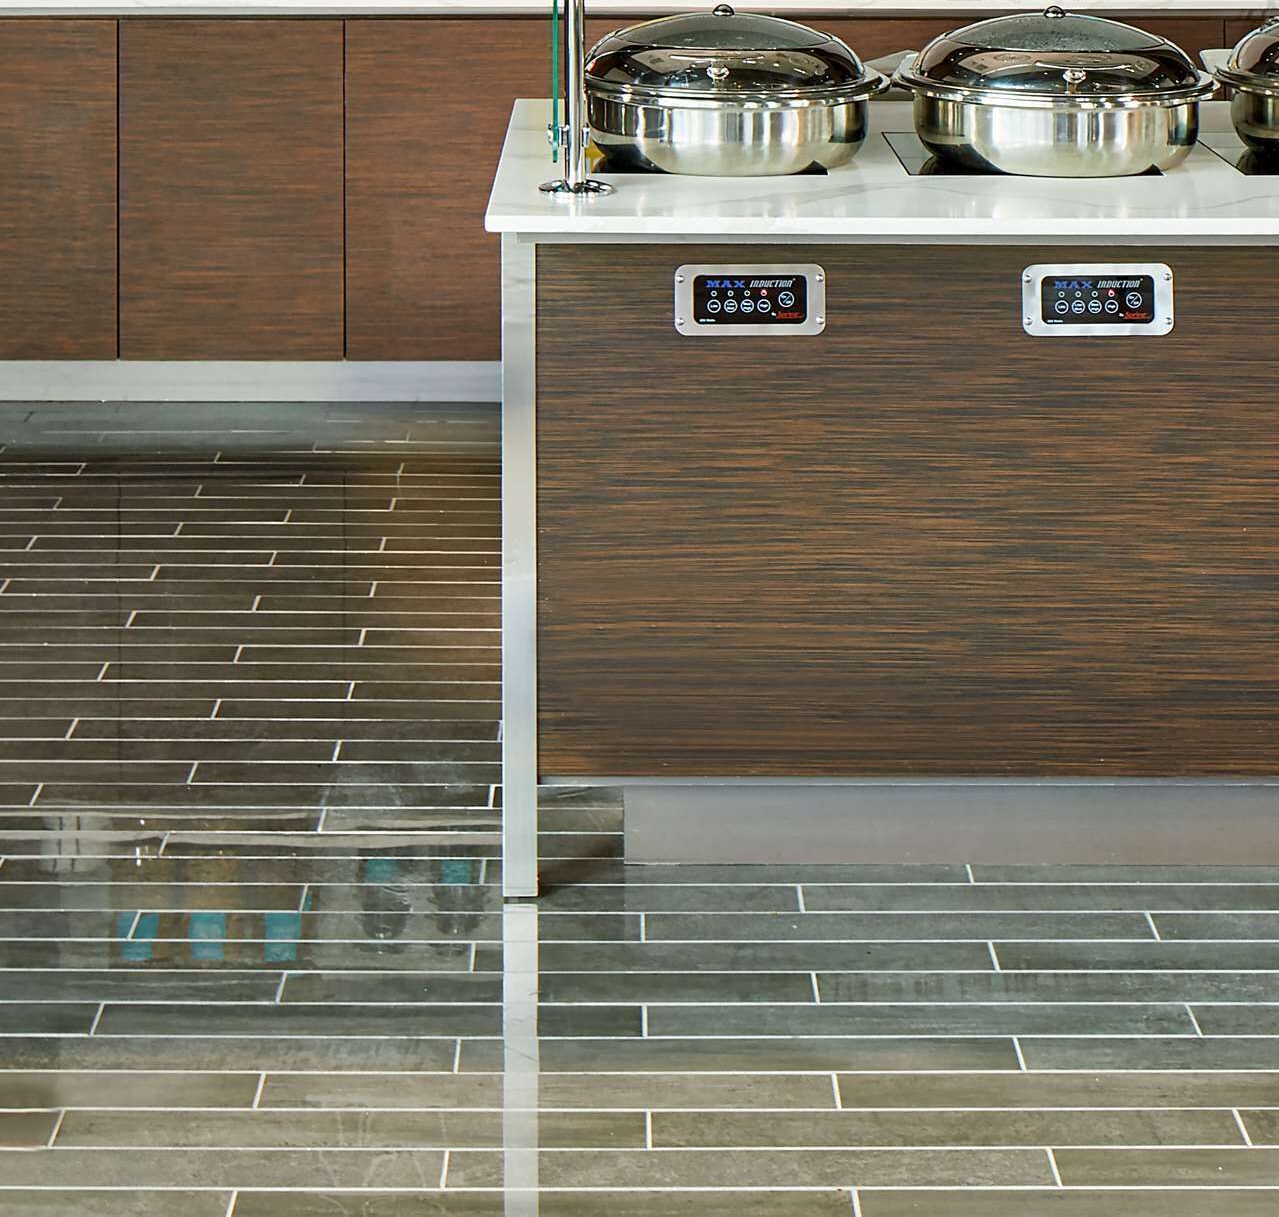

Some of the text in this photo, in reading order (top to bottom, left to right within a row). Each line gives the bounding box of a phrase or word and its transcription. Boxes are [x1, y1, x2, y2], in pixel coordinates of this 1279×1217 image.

[705, 279, 793, 288] MAX INDUCTION
[1054, 279, 1140, 289] MAX INDUCTION
